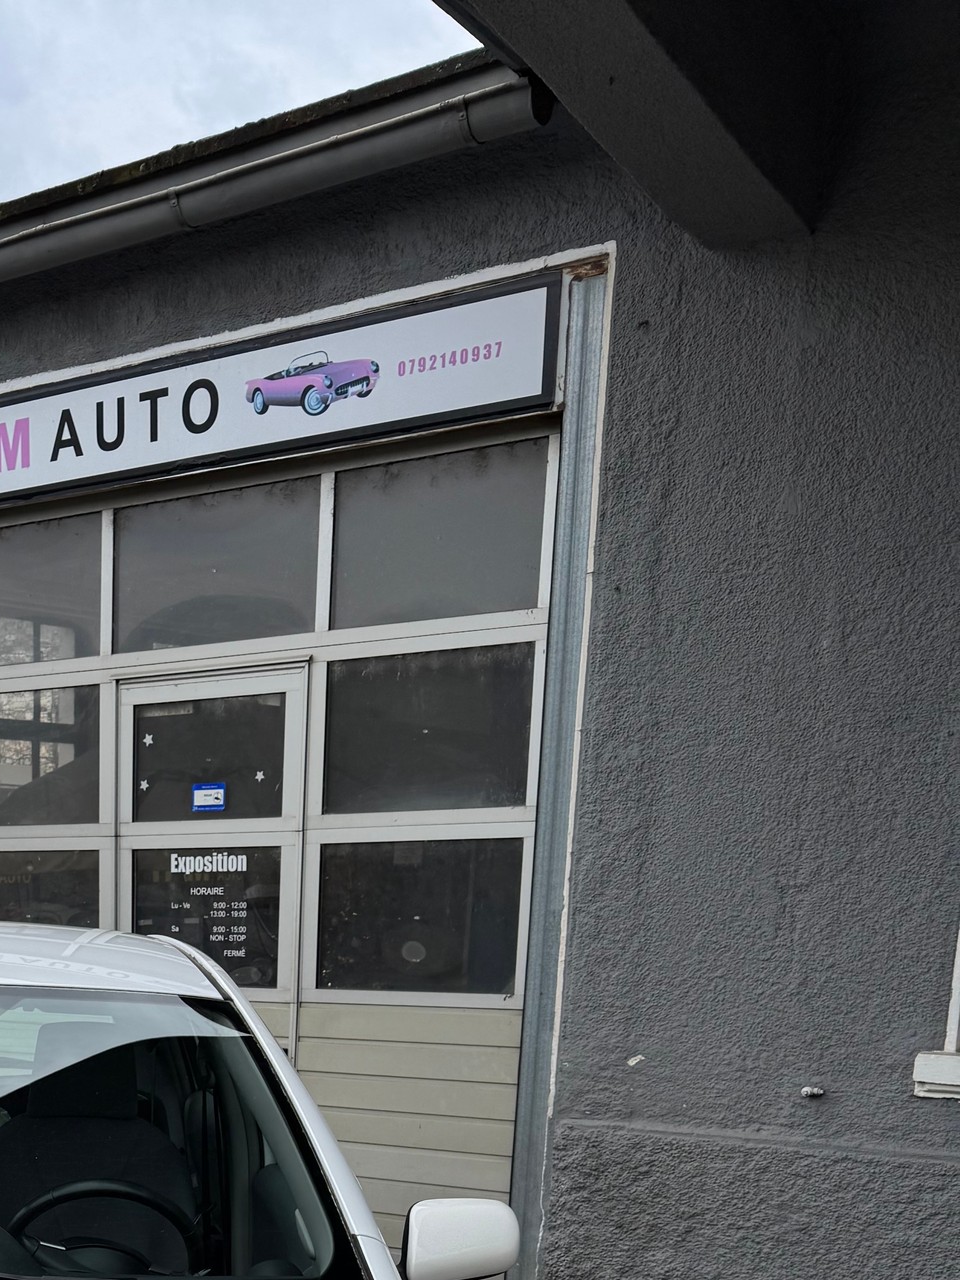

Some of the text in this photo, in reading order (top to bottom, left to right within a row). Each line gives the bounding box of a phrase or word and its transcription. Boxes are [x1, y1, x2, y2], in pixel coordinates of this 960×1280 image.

[396, 341, 504, 377] 0792140937
[49, 378, 220, 462] AUTO
[170, 852, 248, 875] Exposition
[190, 887, 225, 896] HORAIRE
[229, 934, 247, 942] STOP
